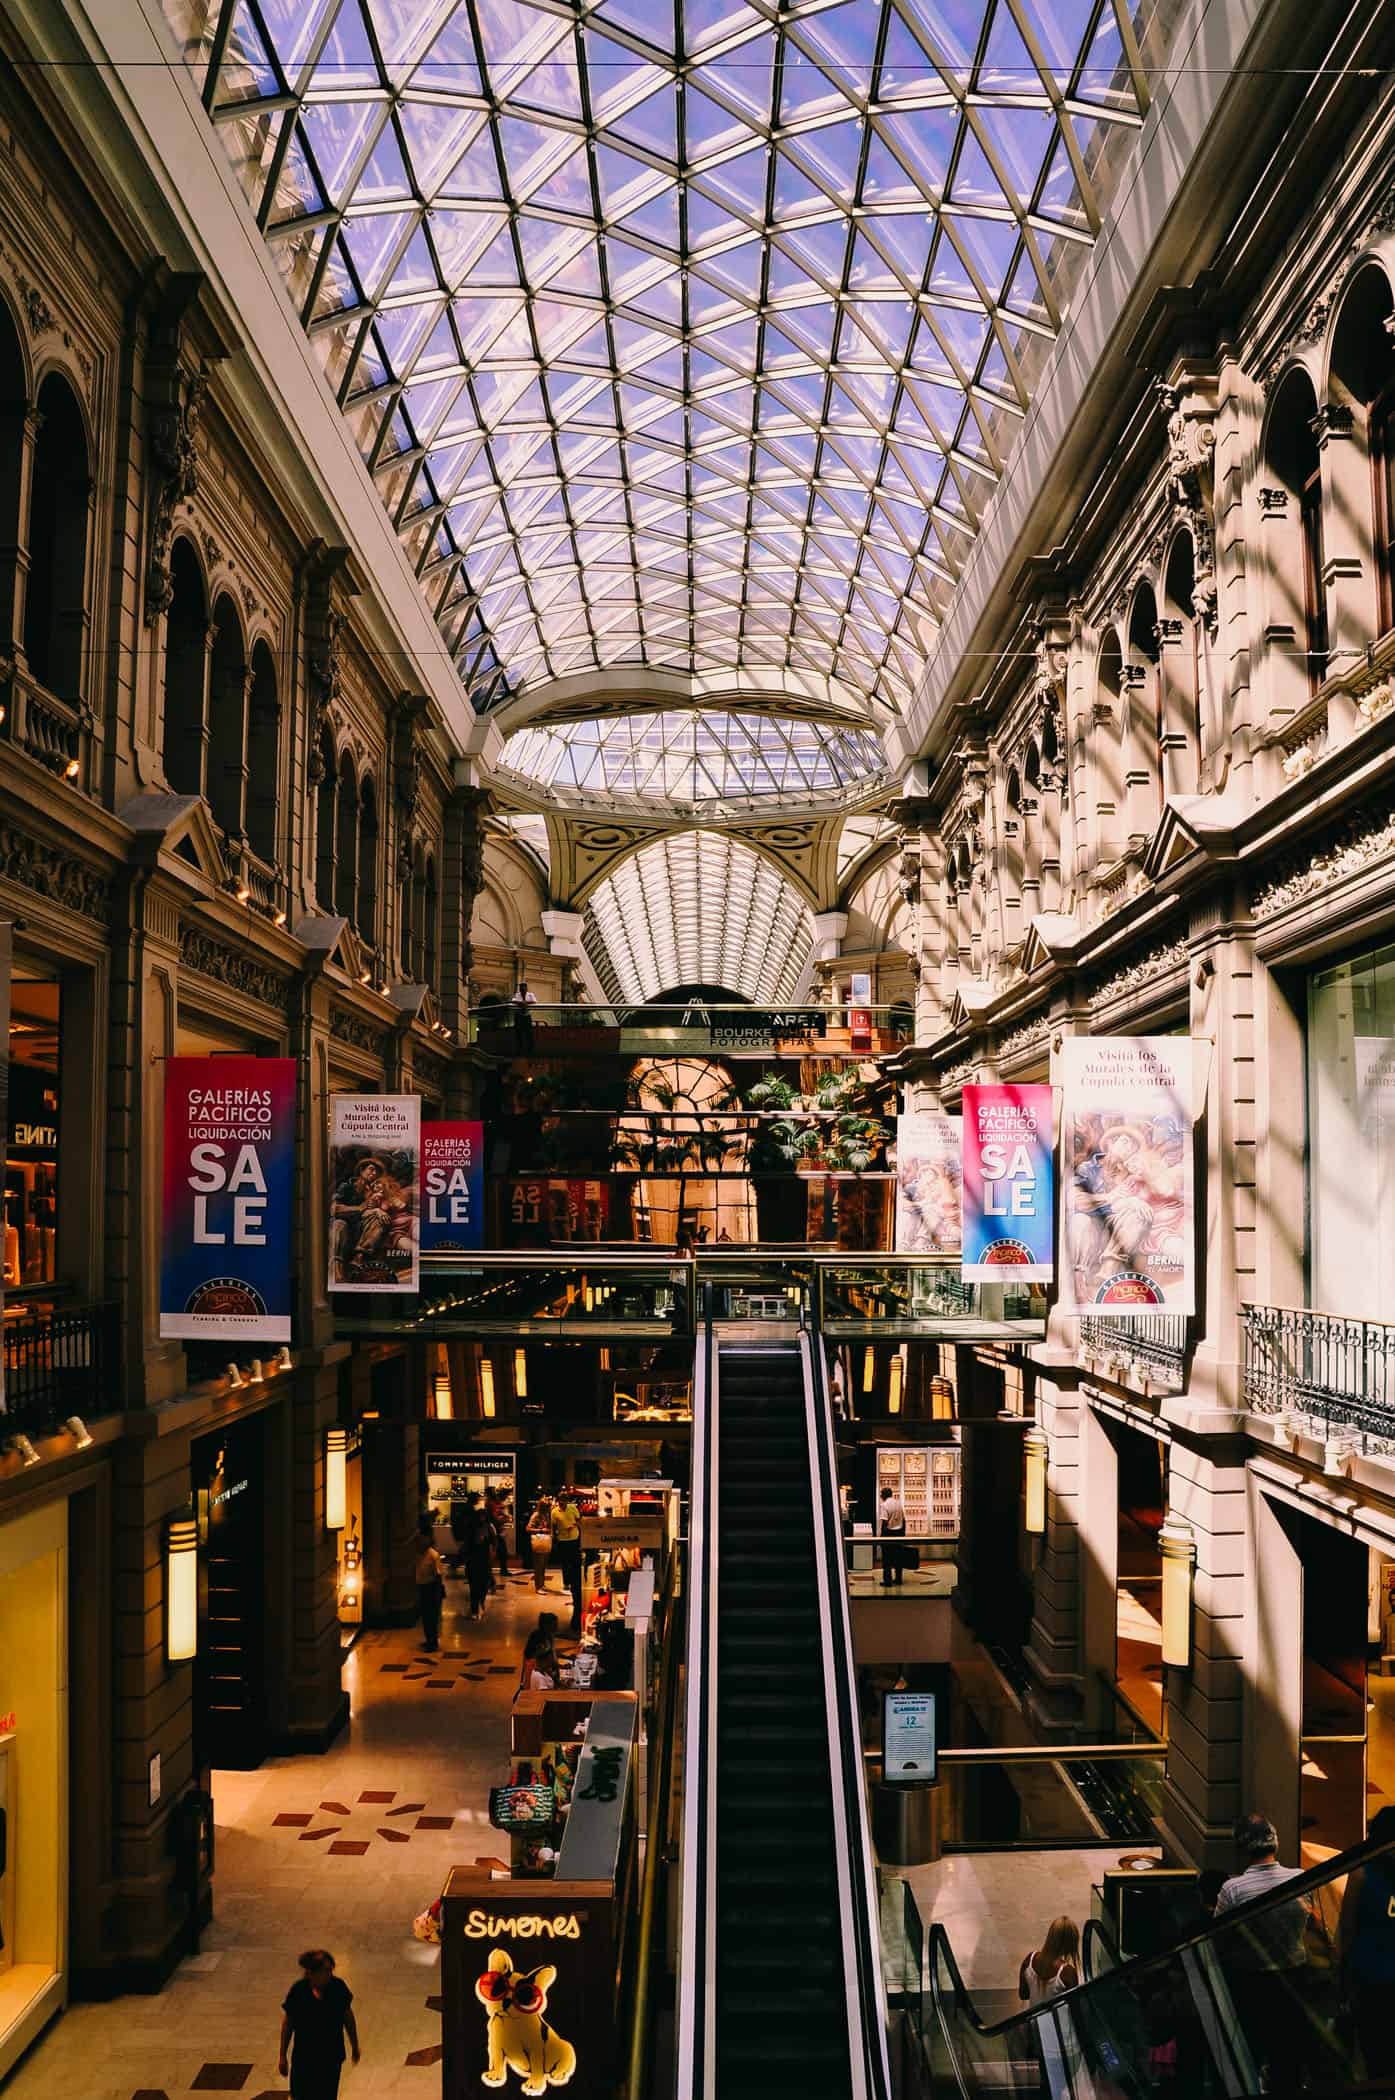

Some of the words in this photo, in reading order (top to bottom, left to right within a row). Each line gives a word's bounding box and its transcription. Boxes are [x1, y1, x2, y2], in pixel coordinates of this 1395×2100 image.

[714, 1028, 772, 1038] BOURKE
[1138, 1050, 1157, 1061] los
[1140, 1063, 1156, 1074] de
[1159, 1063, 1171, 1073] la
[188, 1088, 271, 1105] GALERÍAS
[189, 1104, 272, 1122] PACÍFICO
[353, 1103, 380, 1113] Visitá
[382, 1103, 396, 1112] los
[978, 1104, 1037, 1118] GALERÍAS
[344, 1113, 380, 1121] Murales
[382, 1113, 395, 1121] de
[397, 1113, 406, 1122] la
[188, 1126, 271, 1140] LIQUIDACIÓN
[341, 1122, 374, 1132] Cúpula
[376, 1122, 409, 1131] Central
[424, 1138, 471, 1148] GALERÍAS
[188, 1143, 267, 1193] SA
[425, 1159, 471, 1167] LIQUIDACIÓN
[980, 1145, 1035, 1180] SA
[425, 1168, 469, 1196] SA
[984, 1181, 1036, 1217] LE
[429, 1196, 469, 1223] LE
[193, 1196, 267, 1246] LE
